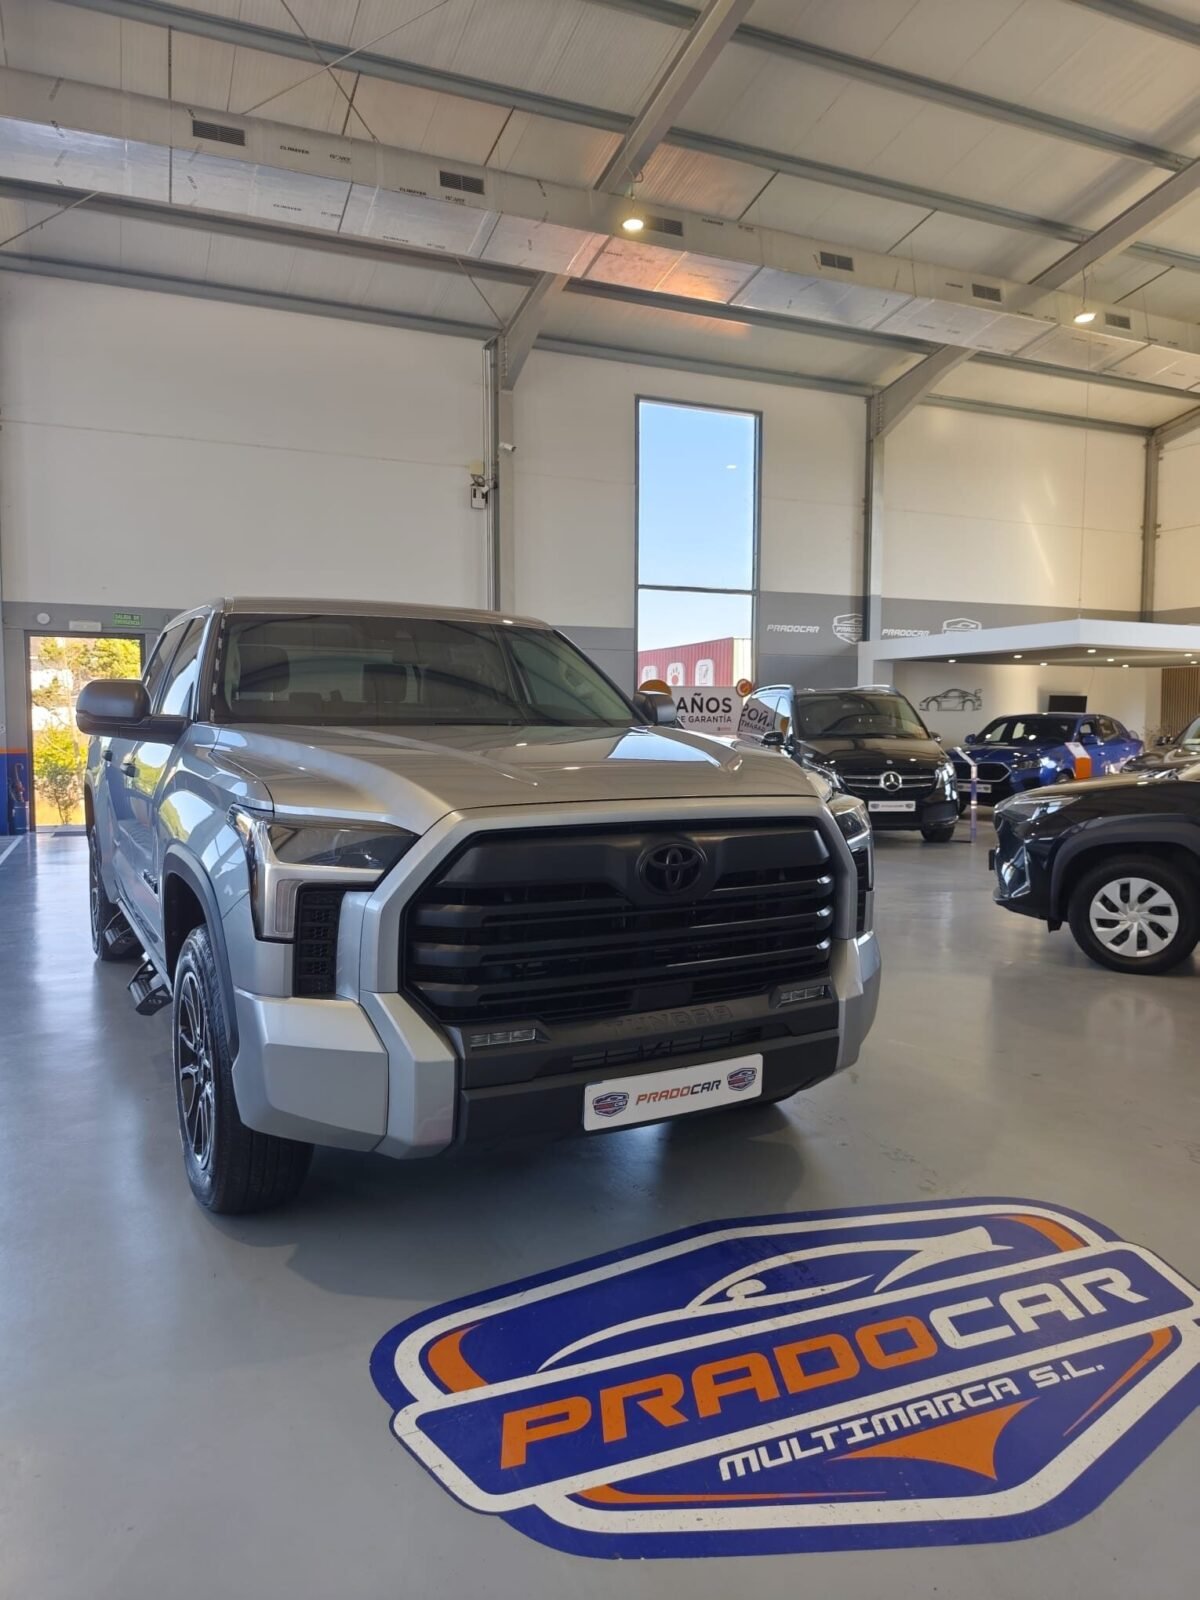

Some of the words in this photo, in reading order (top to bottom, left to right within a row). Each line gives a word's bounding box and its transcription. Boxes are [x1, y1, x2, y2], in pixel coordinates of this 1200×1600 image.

[766, 624, 820, 634] PRADOCAR
[676, 692, 732, 713] AÑOS
[688, 714, 732, 723] GARANTÍA
[606, 1004, 733, 1036] TUNDRA
[635, 1079, 722, 1105] PRADOCAR
[501, 1267, 1149, 1469] PRADOCAR
[718, 1377, 1021, 1481] MULTIMARCA
[1028, 1360, 1105, 1388] S.L.
